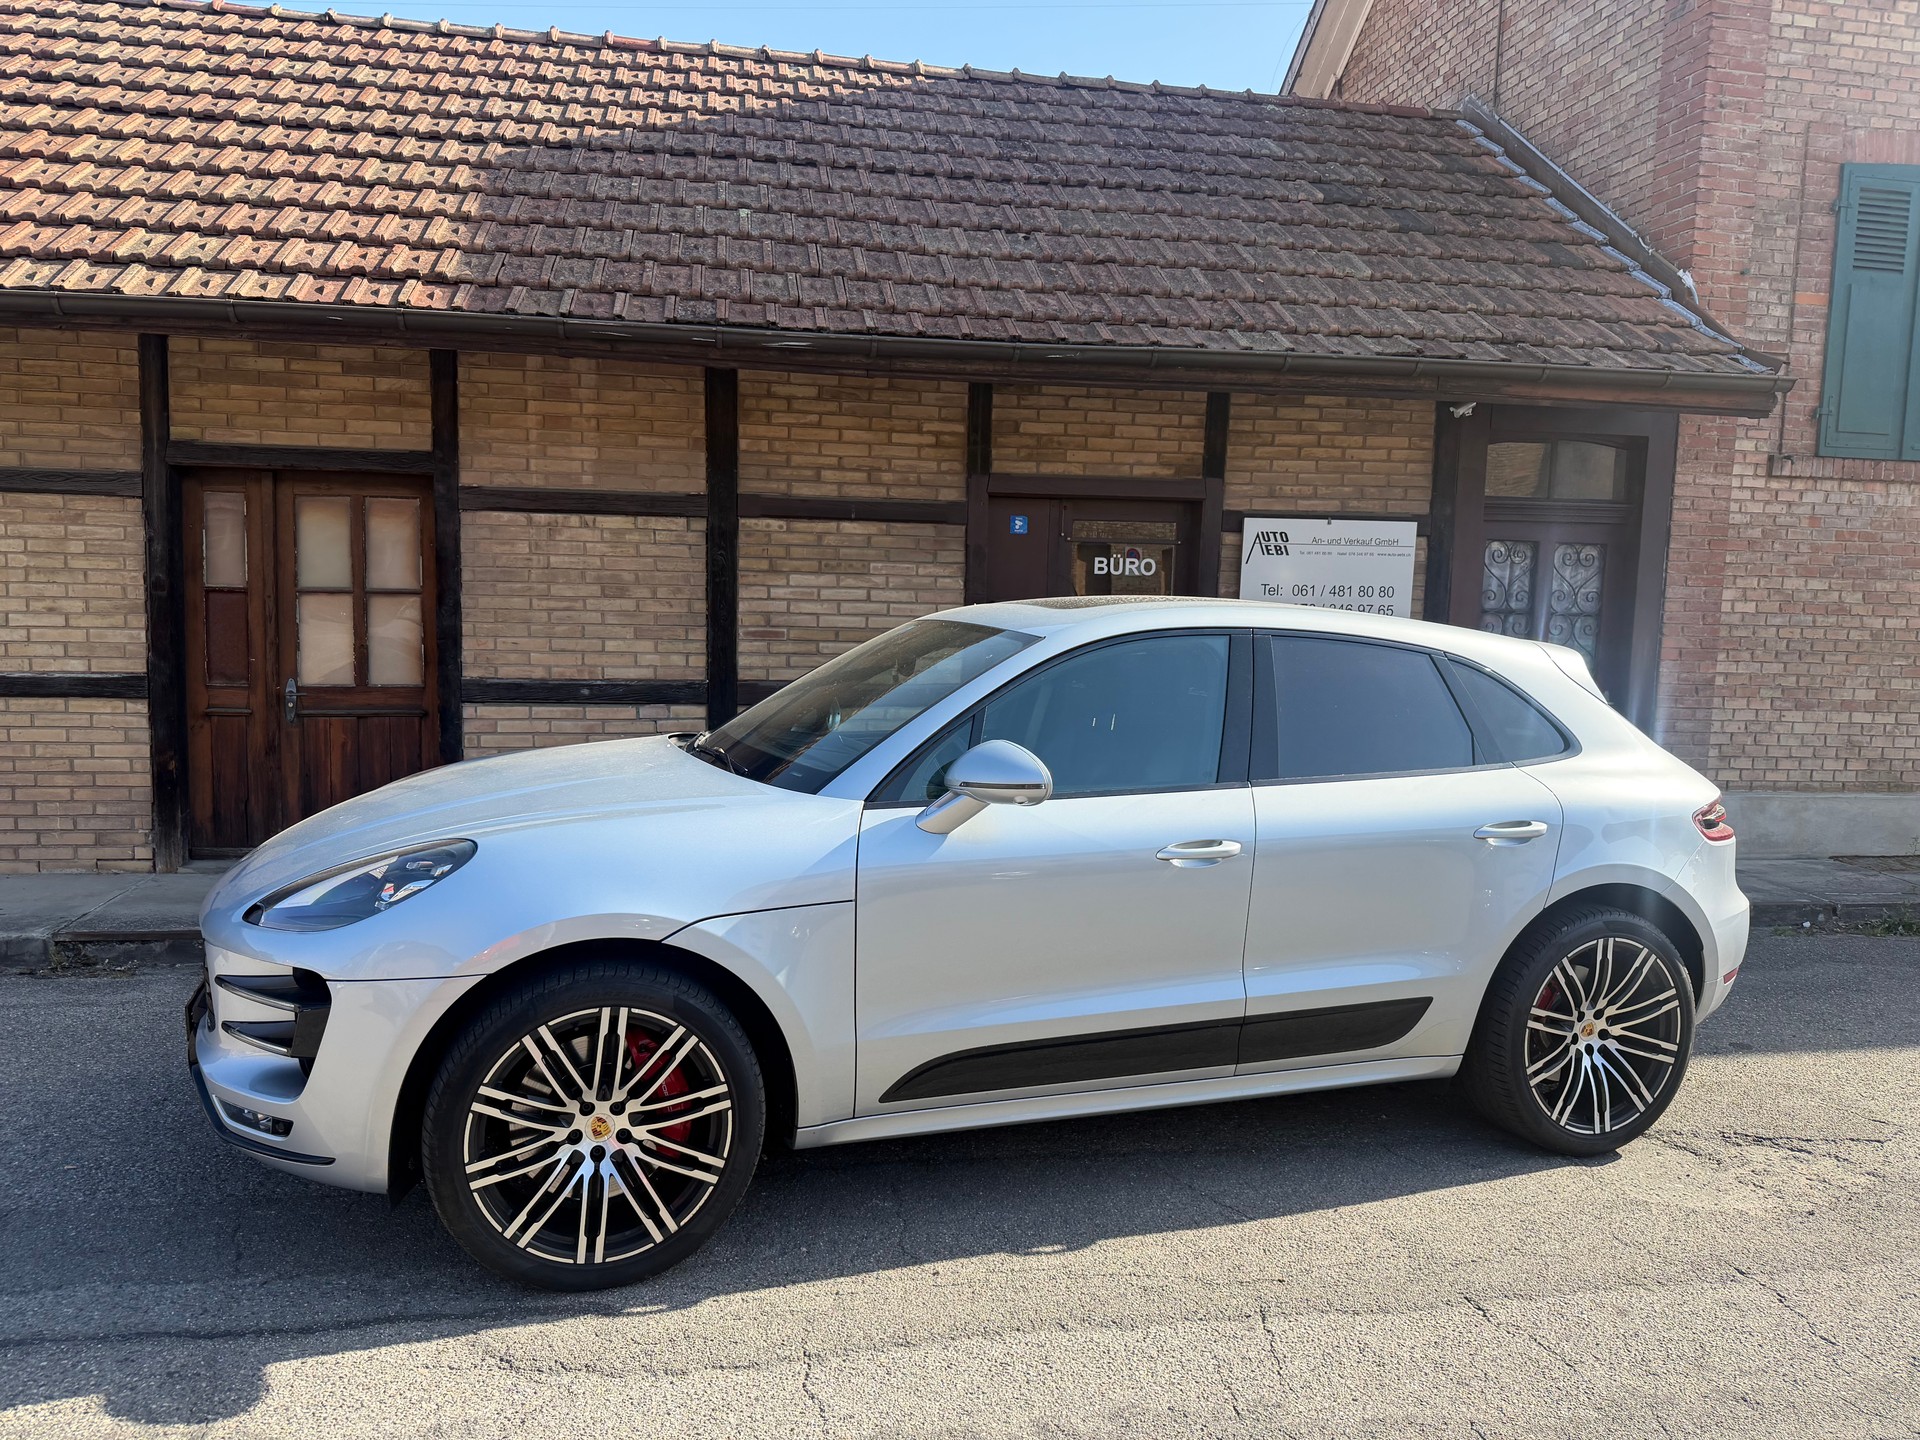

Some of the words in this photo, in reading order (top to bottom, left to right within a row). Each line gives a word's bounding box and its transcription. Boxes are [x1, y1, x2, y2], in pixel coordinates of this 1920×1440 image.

[1311, 536, 1326, 544] An-
[1327, 537, 1342, 545] und
[1344, 537, 1373, 546] Verkauf
[1374, 538, 1399, 546] GmbH
[1093, 553, 1156, 576] BÜRO
[1261, 583, 1283, 597] Tel:
[1291, 584, 1316, 597] 061
[1320, 584, 1326, 597] /
[1329, 585, 1352, 598] 481
[1357, 585, 1374, 598] 80
[1378, 585, 1395, 599] 80
[1377, 604, 1394, 617] 65
